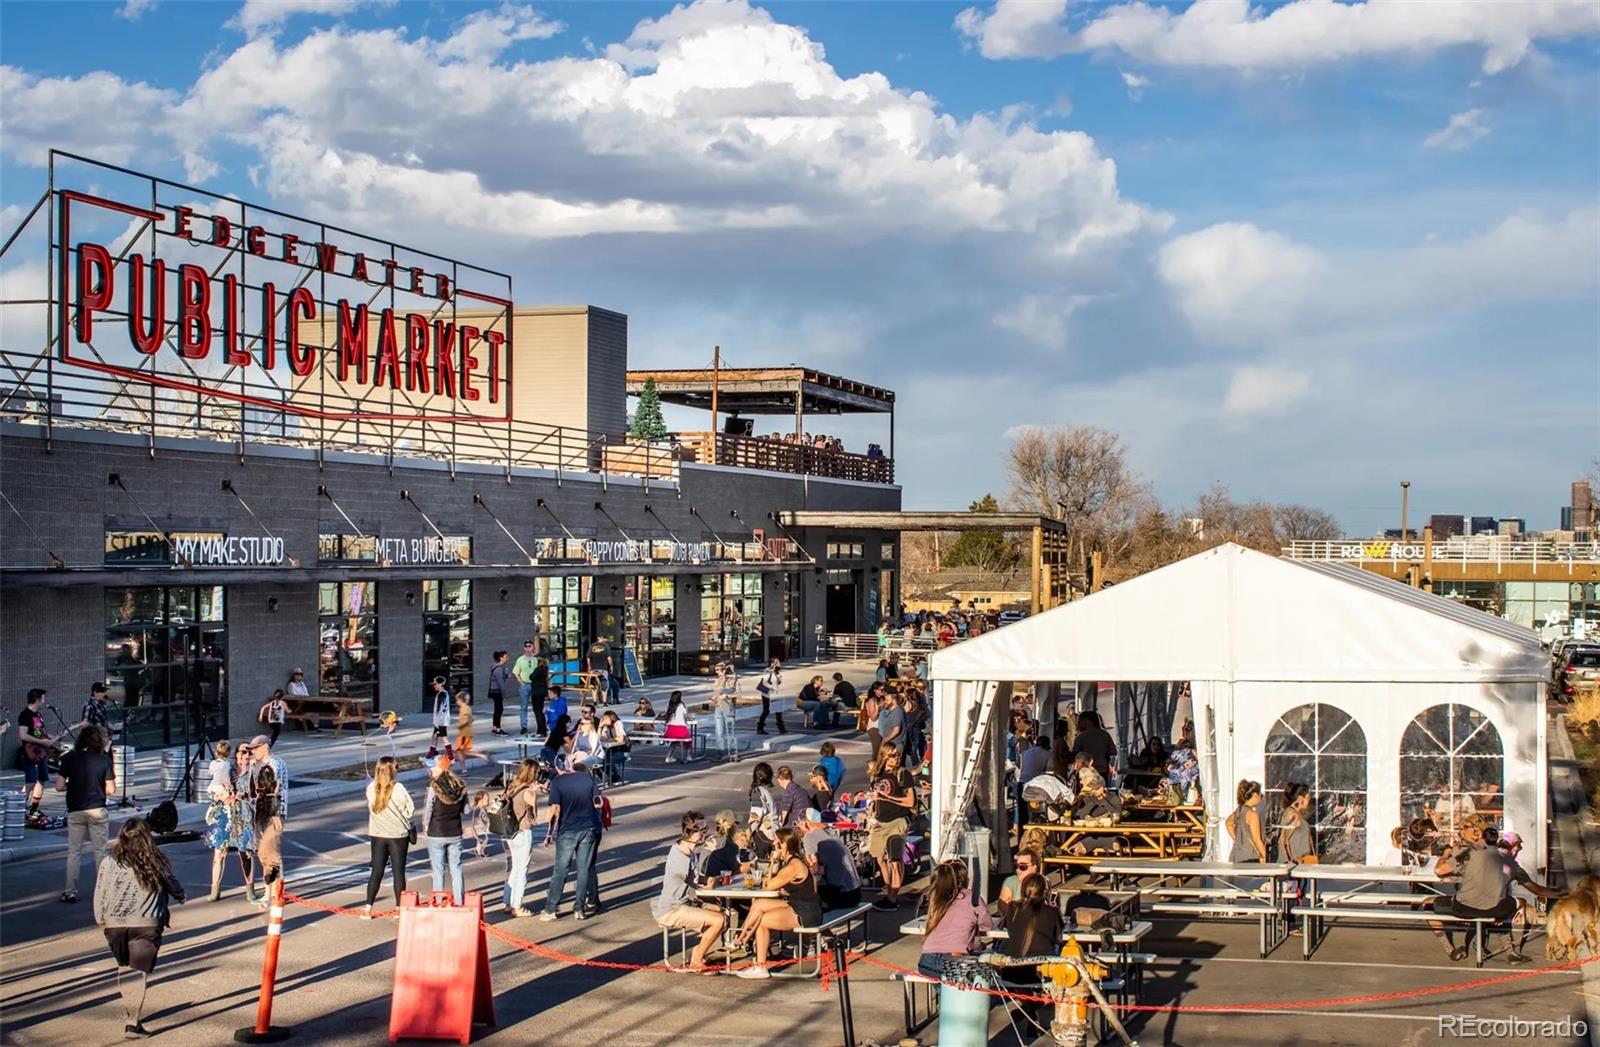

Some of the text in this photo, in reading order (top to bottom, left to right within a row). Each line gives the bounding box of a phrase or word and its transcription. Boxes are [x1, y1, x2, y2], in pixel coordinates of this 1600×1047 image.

[174, 205, 455, 300] EDGEWATER
[76, 242, 505, 404] PUBLIC MARKET
[175, 536, 199, 564] MY
[376, 538, 459, 563] META BURGER
[586, 541, 613, 561] HAPPY
